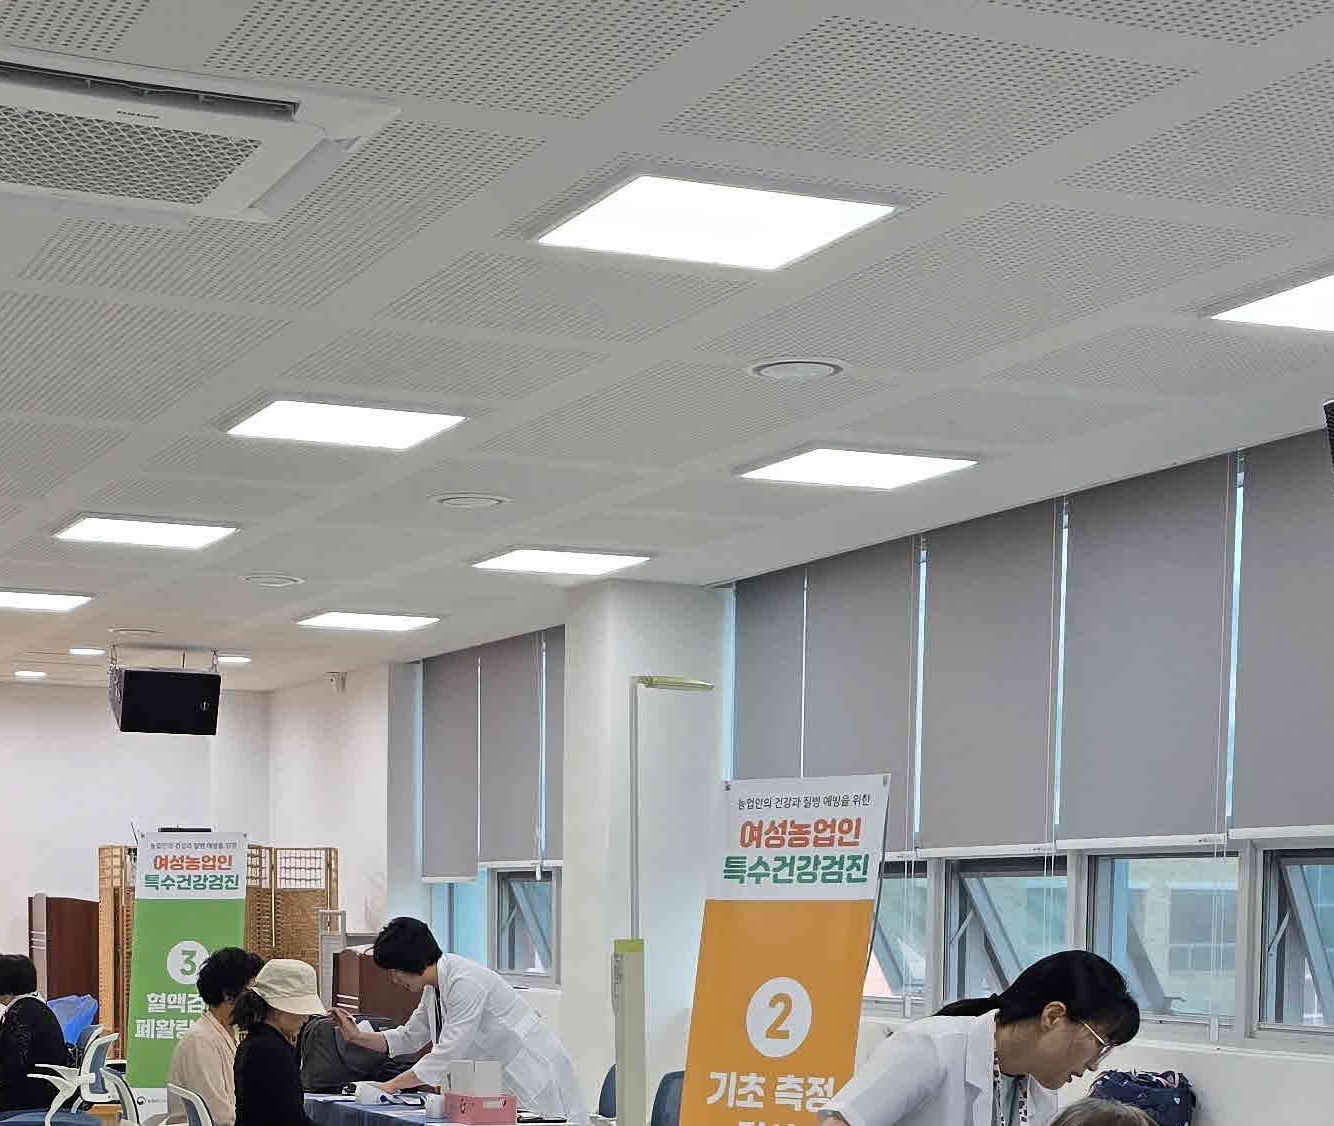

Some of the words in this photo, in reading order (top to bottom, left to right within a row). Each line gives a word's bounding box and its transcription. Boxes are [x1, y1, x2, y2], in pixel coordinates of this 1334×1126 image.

[738, 797, 772, 810] 농업인의
[774, 797, 800, 809] 건강과
[803, 796, 821, 808] 질병
[823, 795, 850, 807] 예방을
[852, 794, 870, 806] 위한
[739, 818, 861, 849] 여성농업인
[154, 855, 233, 870] 여성농업인
[722, 854, 869, 885] 특수건강검진
[144, 874, 239, 890] 특수건강검진
[180, 949, 197, 976] 3
[764, 991, 793, 1040] 2
[706, 1070, 765, 1110] 기초
[773, 1075, 835, 1113] 측정
